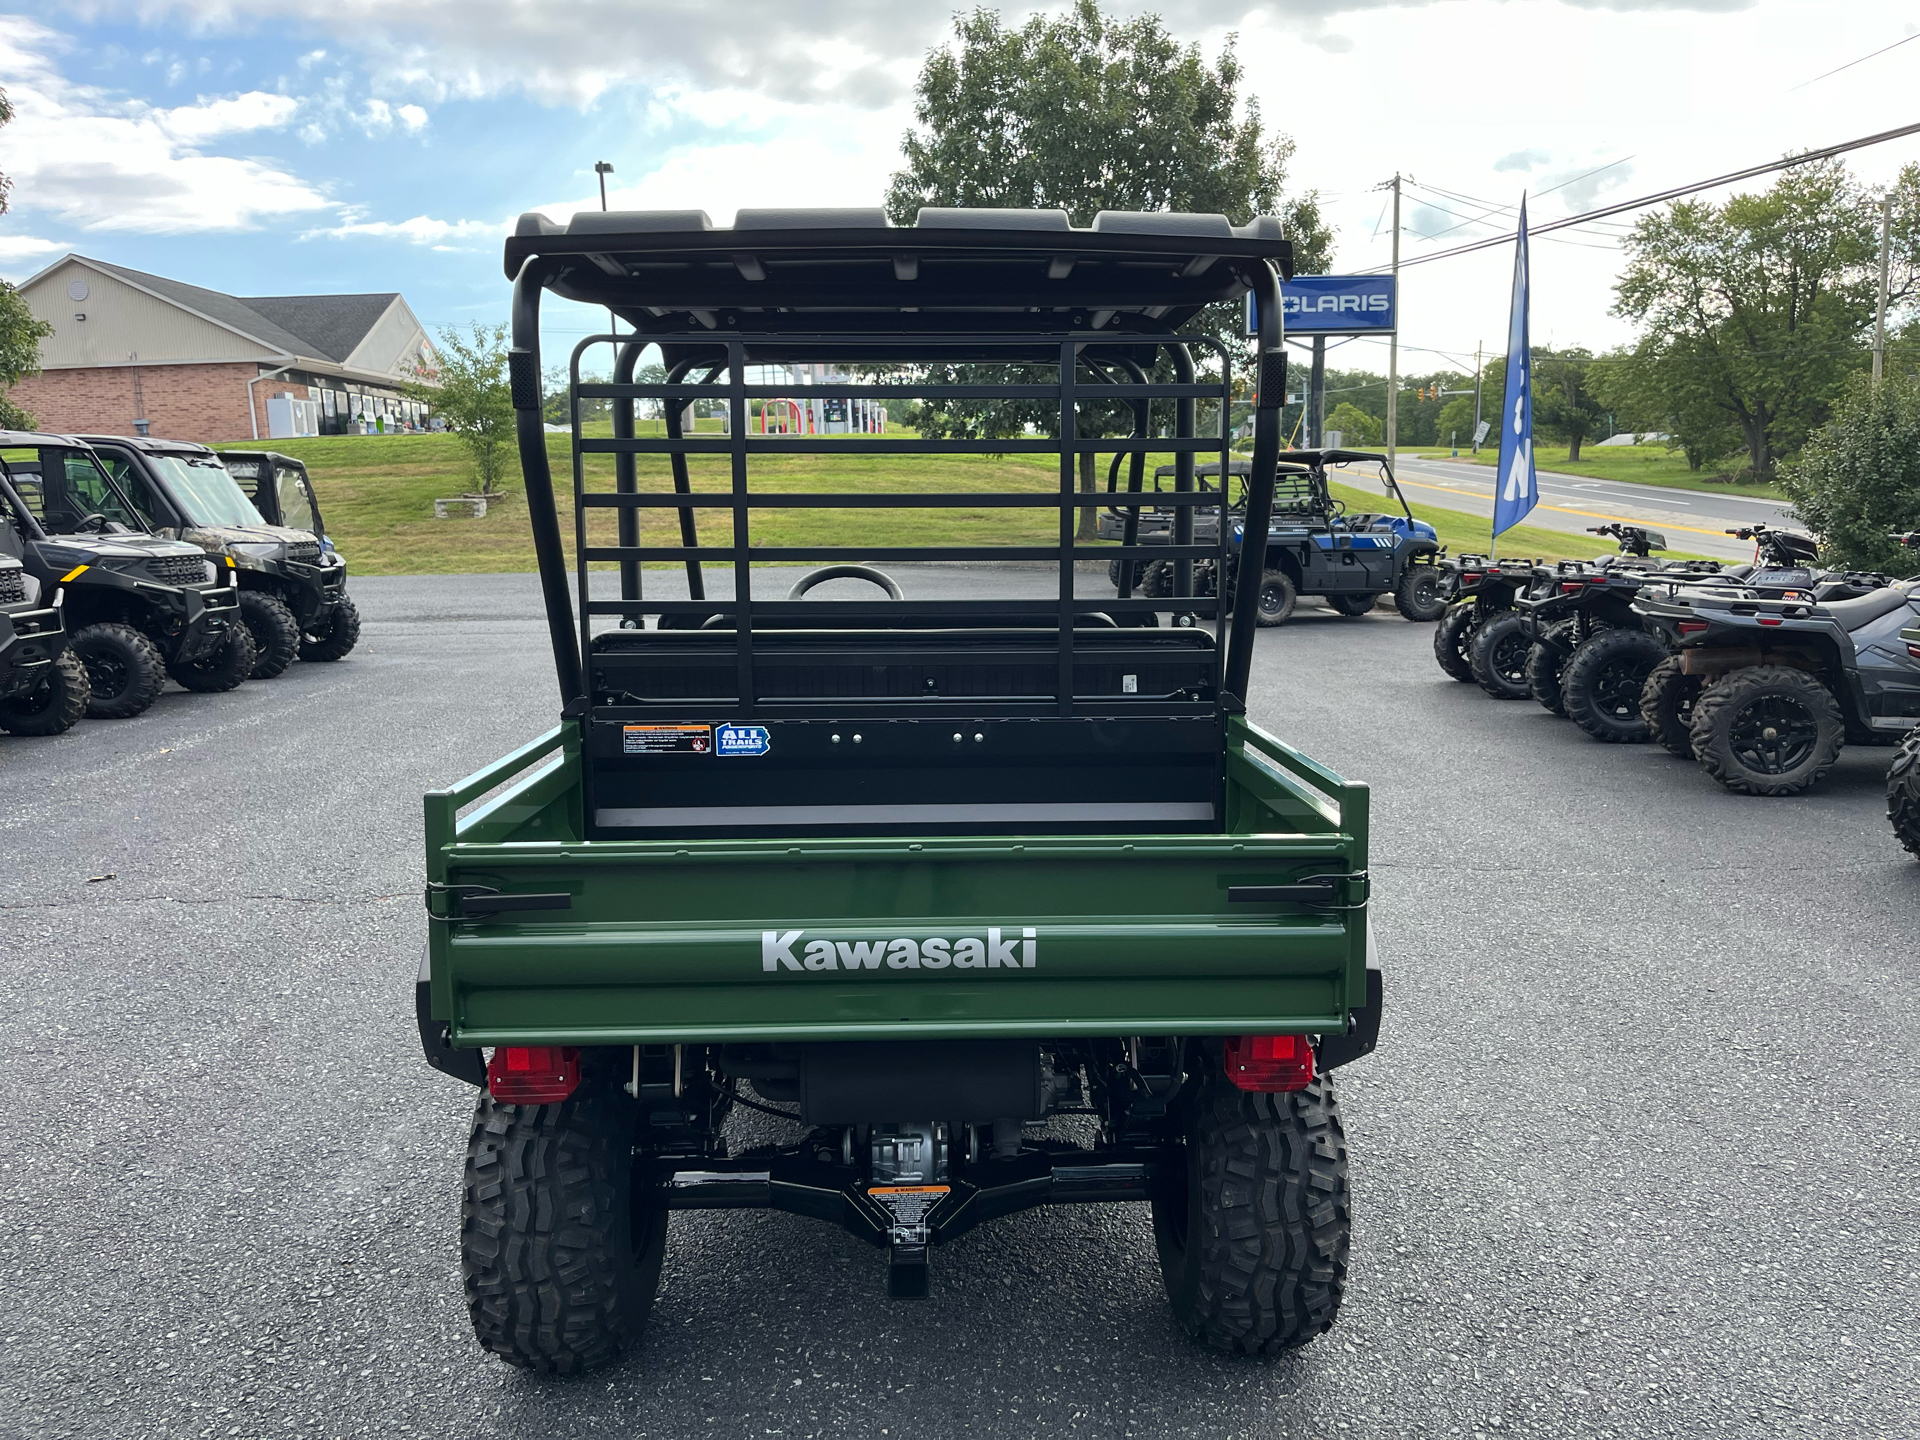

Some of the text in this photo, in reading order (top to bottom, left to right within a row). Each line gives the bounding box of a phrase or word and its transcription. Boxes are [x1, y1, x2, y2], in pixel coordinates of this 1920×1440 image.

[1282, 295, 1390, 312] OLARIS
[722, 730, 762, 739] ALL
[762, 927, 1037, 971] Kawasaki
